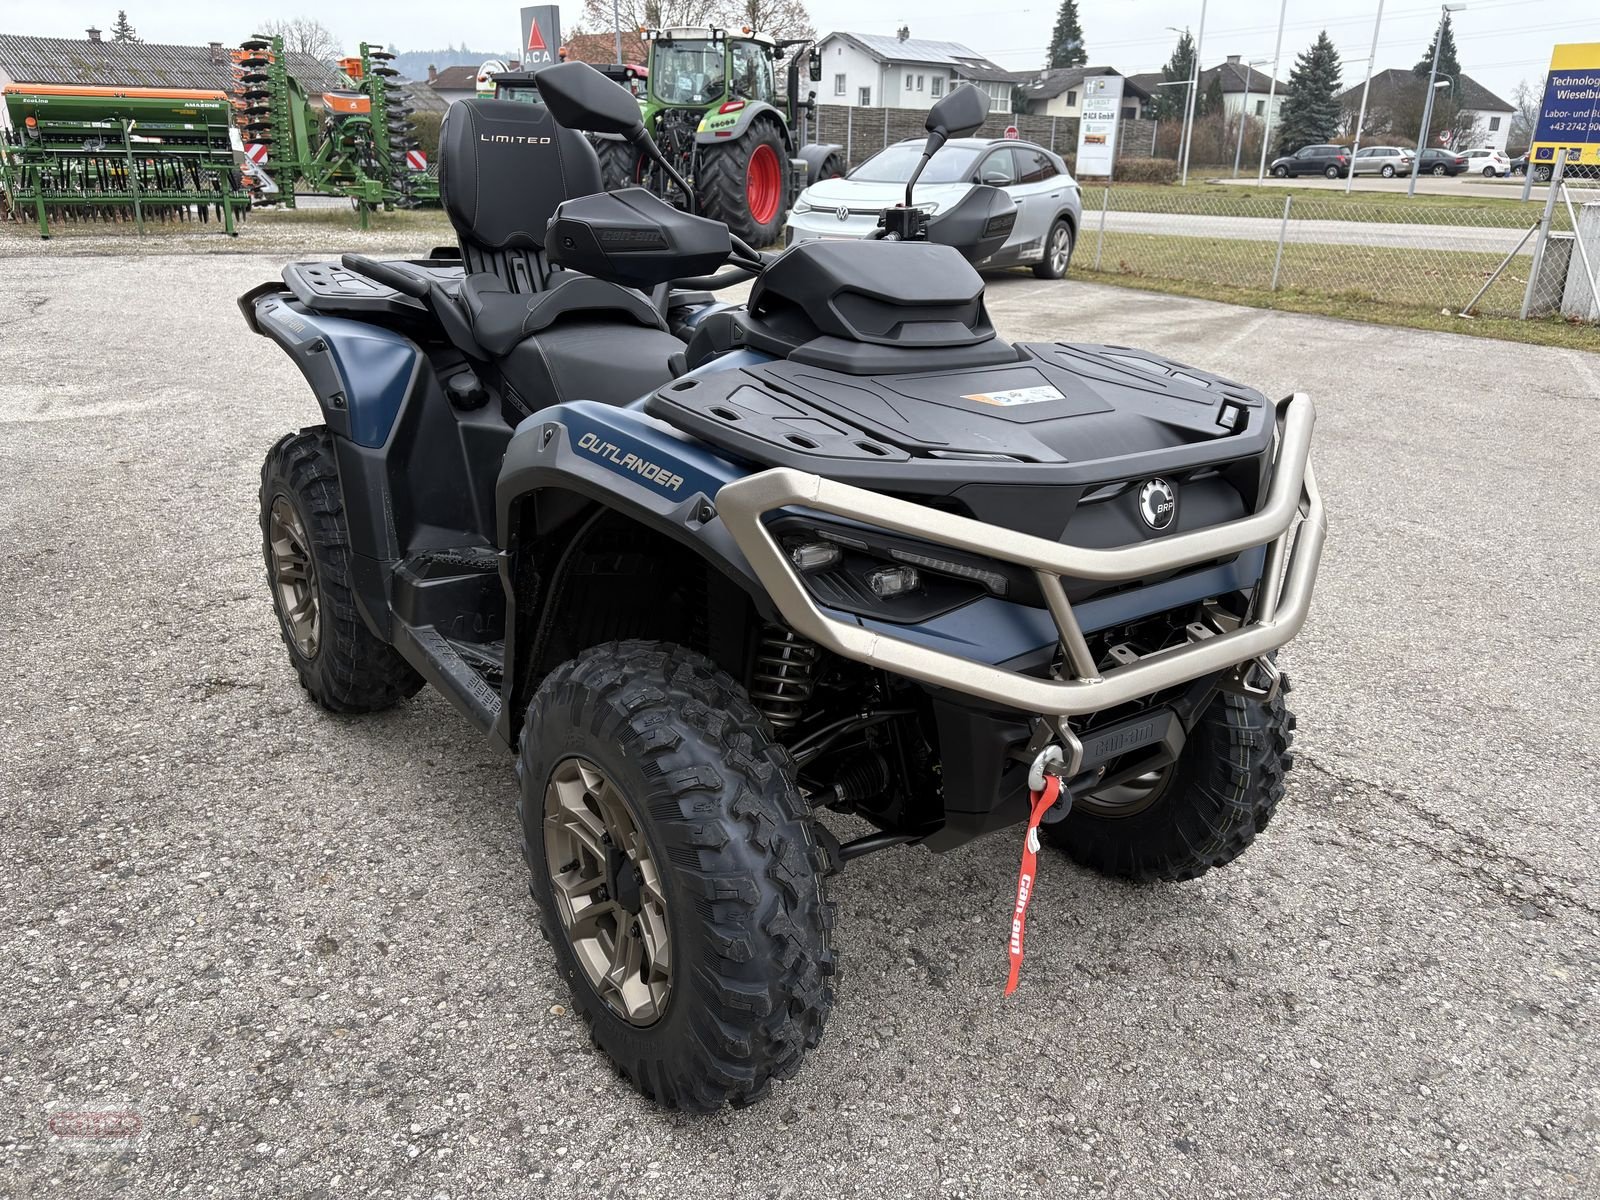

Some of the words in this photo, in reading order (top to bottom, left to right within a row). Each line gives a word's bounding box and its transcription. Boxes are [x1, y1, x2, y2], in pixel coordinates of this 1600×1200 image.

[525, 50, 552, 64] ACA
[1544, 109, 1571, 118] Labor-
[1572, 109, 1590, 118] und
[1549, 121, 1566, 131] +43
[1566, 121, 1587, 131] 2742
[480, 133, 552, 144] LIMITED
[577, 432, 684, 492] OUTLANDER
[1157, 502, 1173, 514] BRP
[1096, 723, 1154, 756] can-am
[1011, 873, 1031, 956] can-am
